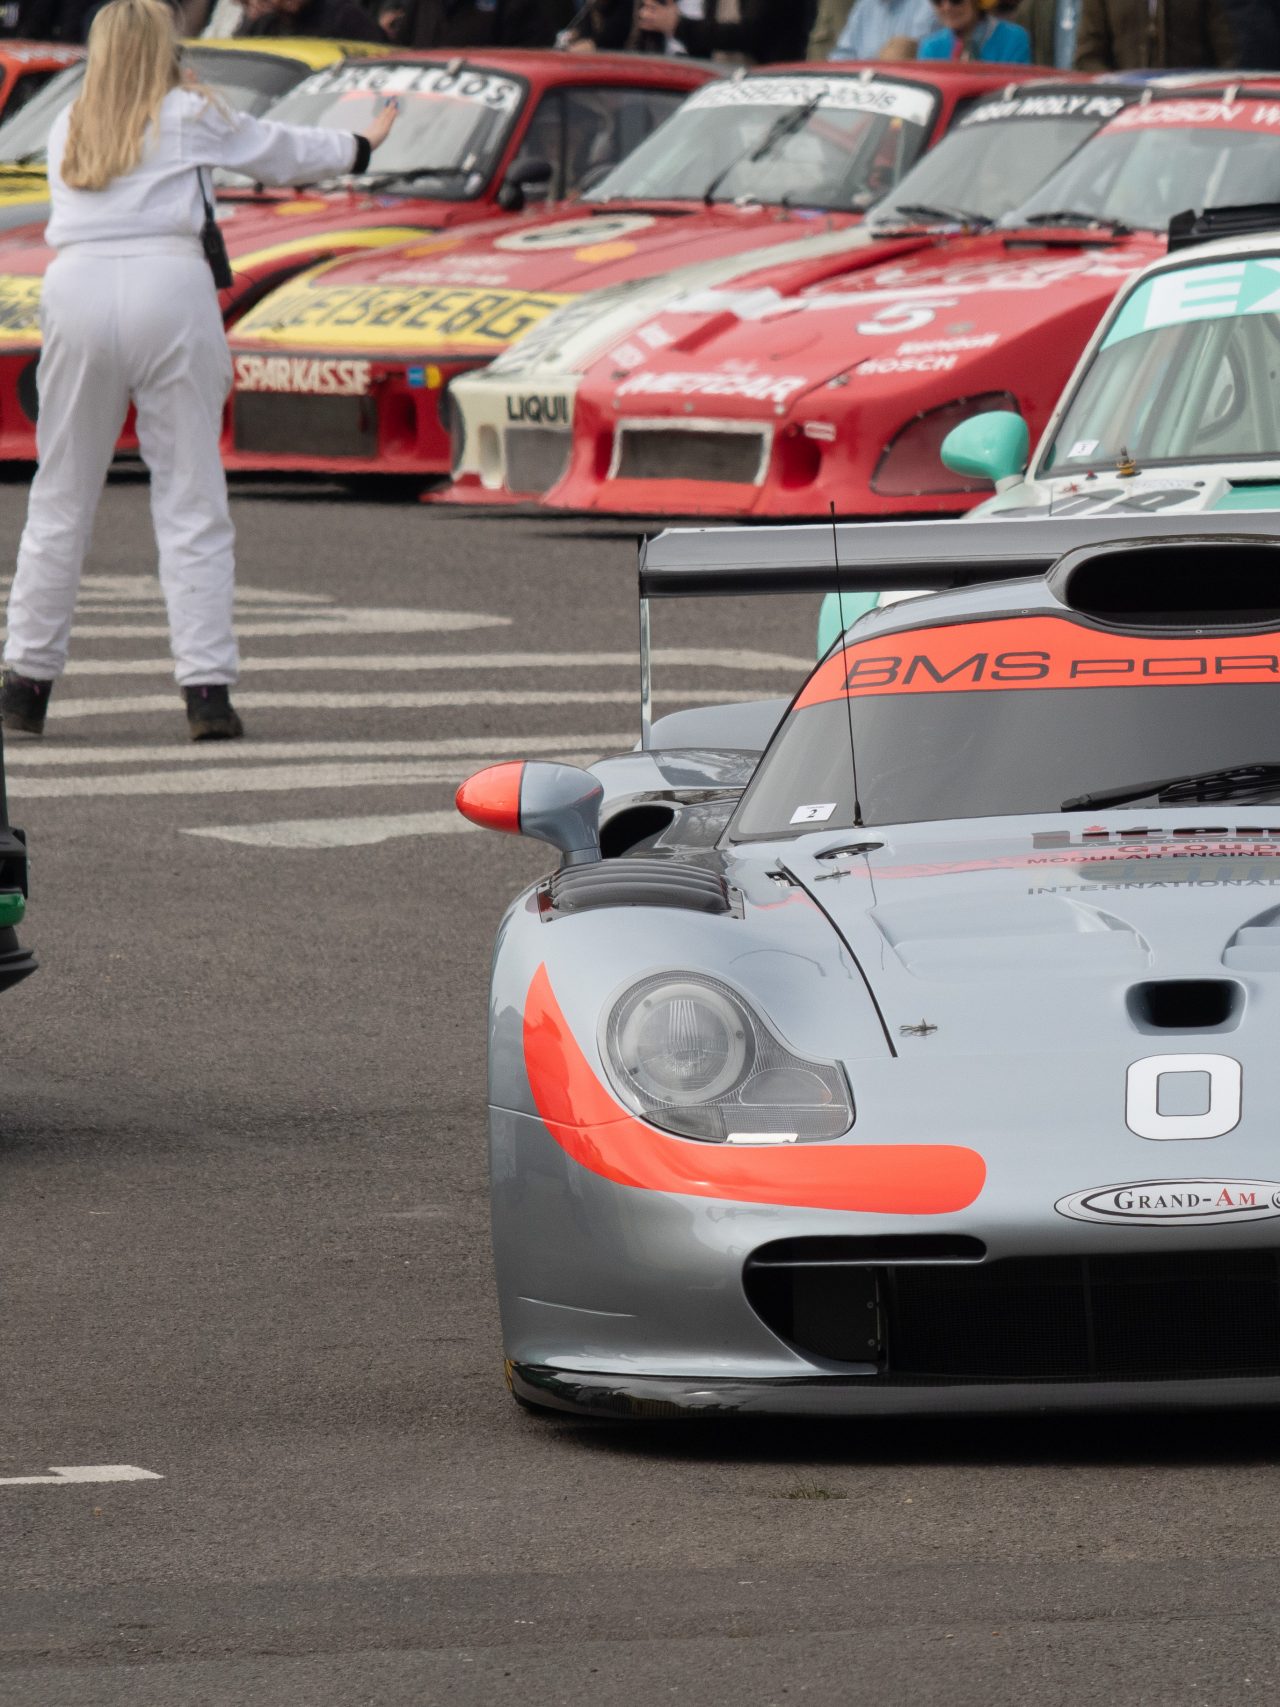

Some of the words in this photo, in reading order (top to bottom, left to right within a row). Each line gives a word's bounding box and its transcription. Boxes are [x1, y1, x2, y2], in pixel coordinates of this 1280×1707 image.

[856, 297, 960, 335] 5
[235, 355, 373, 395] SPARKASSE
[856, 353, 960, 377] BOSCH
[507, 395, 569, 423] LIQUI
[841, 650, 1051, 691] BMS
[1027, 853, 1162, 865] MODULAR
[1117, 843, 1278, 853] Group
